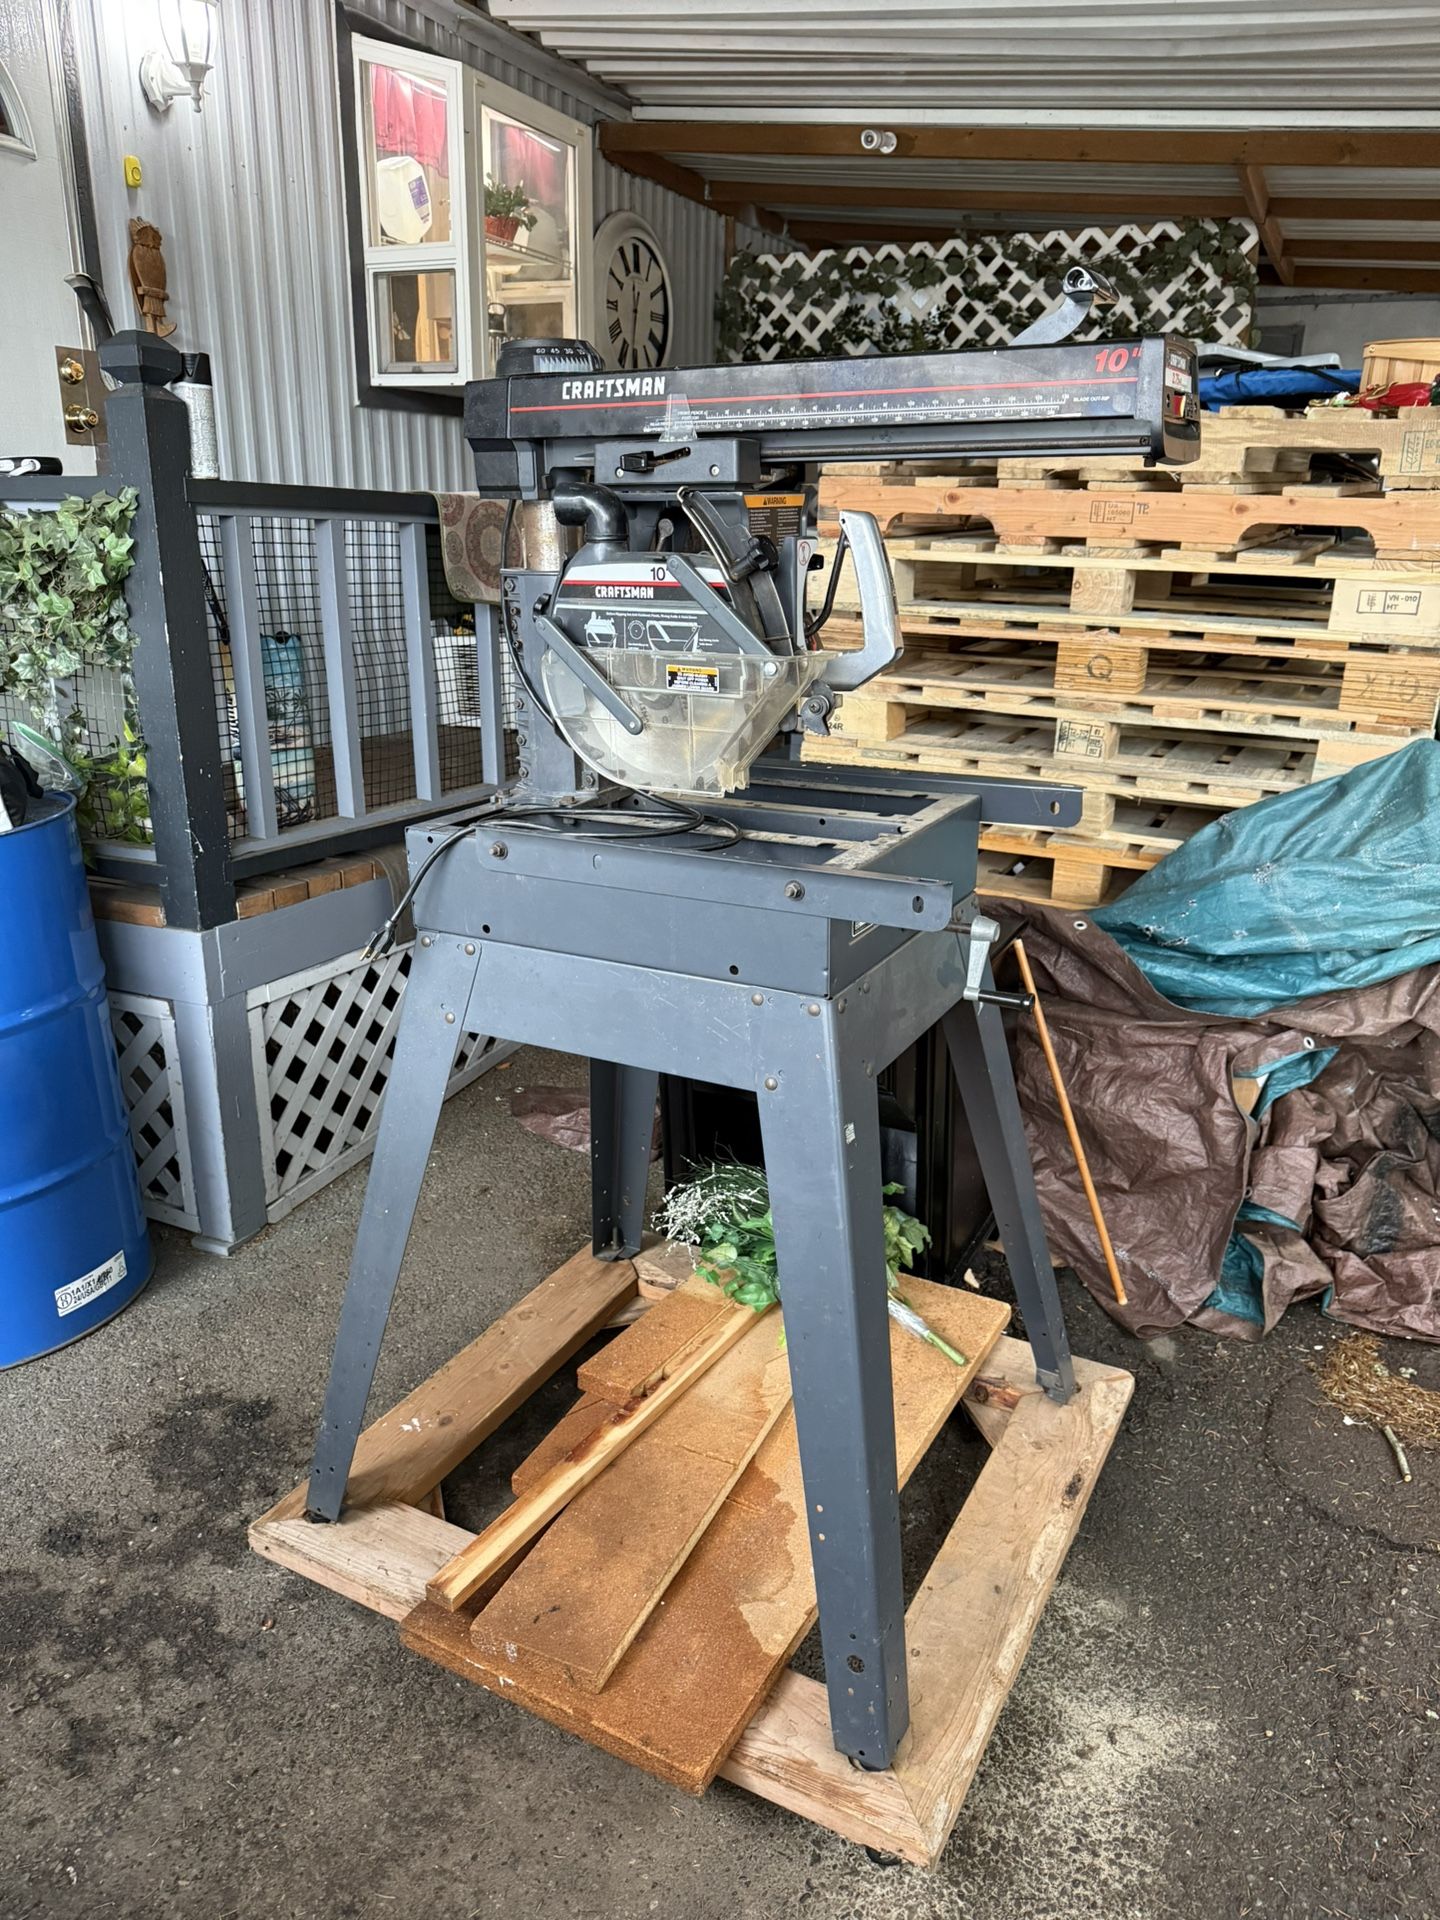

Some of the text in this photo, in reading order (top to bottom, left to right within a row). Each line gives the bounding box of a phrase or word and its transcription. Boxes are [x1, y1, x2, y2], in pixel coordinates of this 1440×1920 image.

[562, 376, 666, 400] CRAFTSMAN
[767, 496, 787, 505] WARNING
[595, 586, 654, 600] CRAFTSMAN
